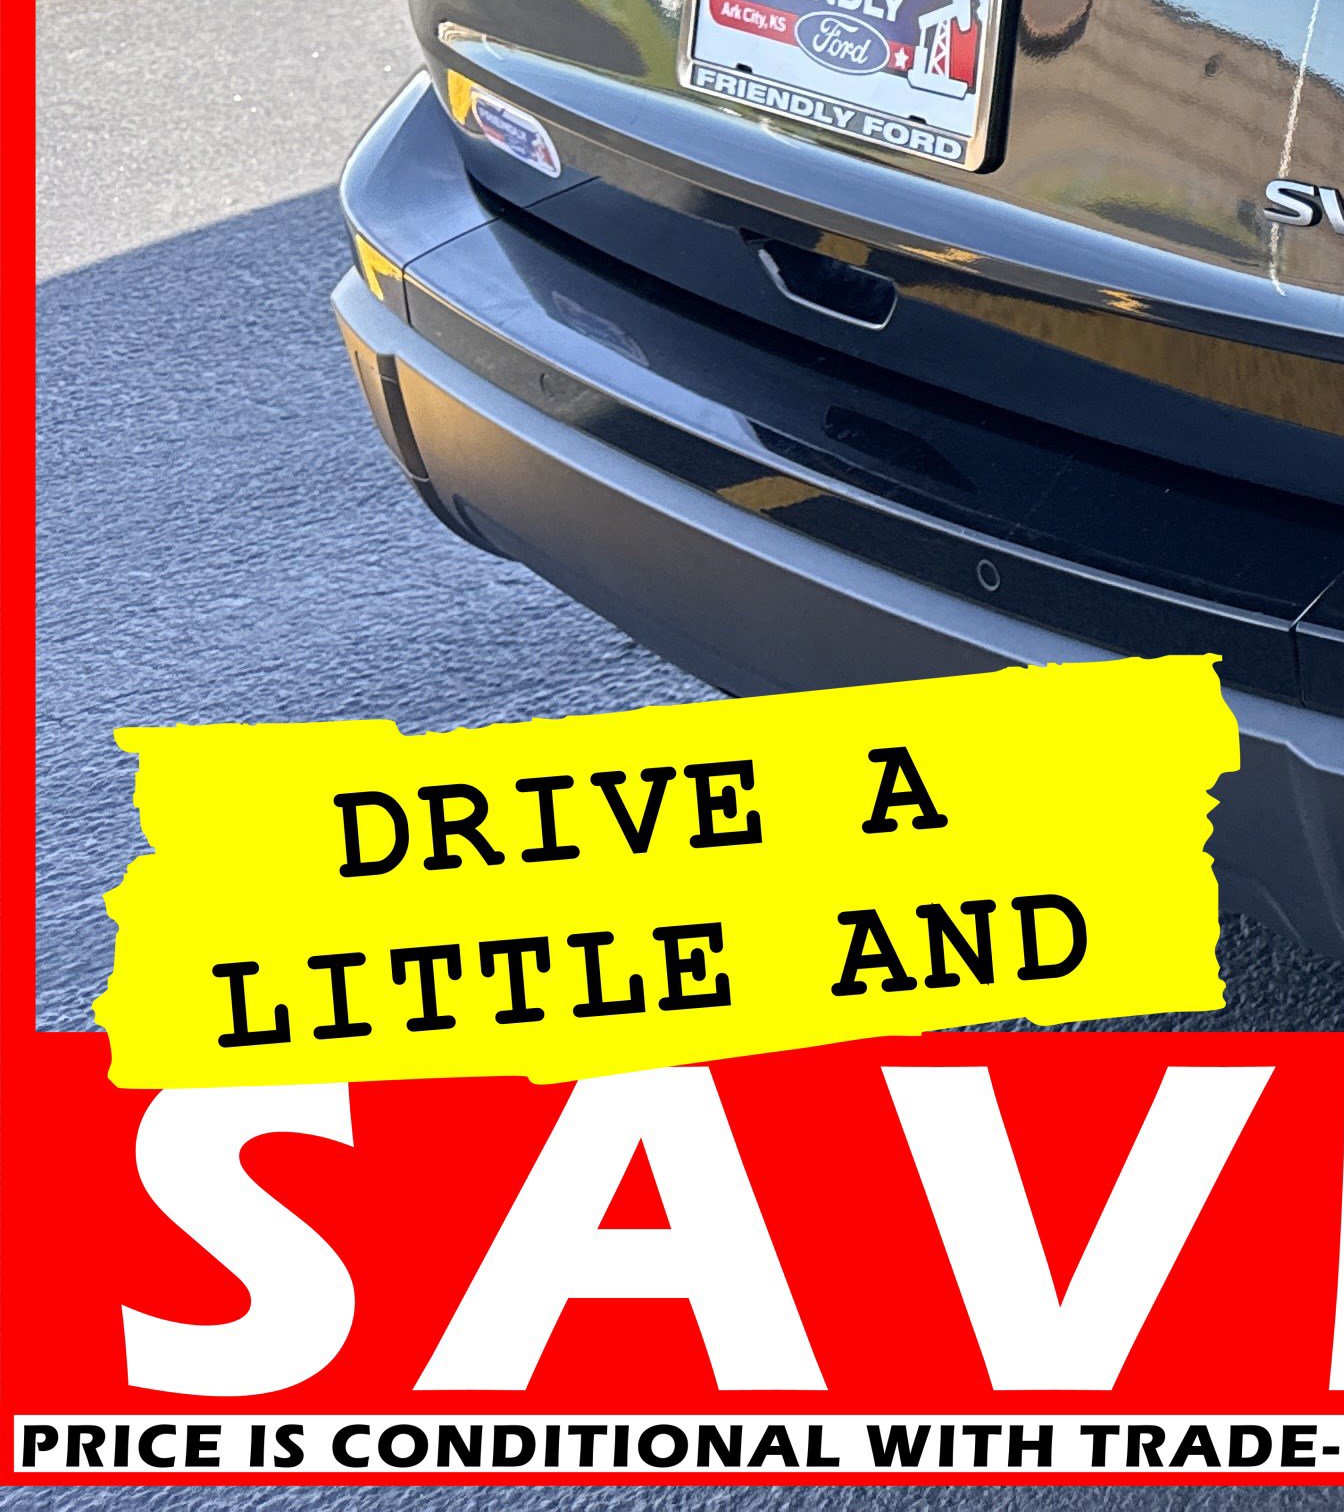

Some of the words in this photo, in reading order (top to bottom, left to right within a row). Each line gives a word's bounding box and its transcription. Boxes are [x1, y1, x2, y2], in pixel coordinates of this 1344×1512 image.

[721, 1, 742, 20] Ark
[769, 14, 787, 33] KS
[812, 16, 872, 66] Ford
[695, 67, 855, 125] FRIENDLY
[862, 115, 962, 162] FORD
